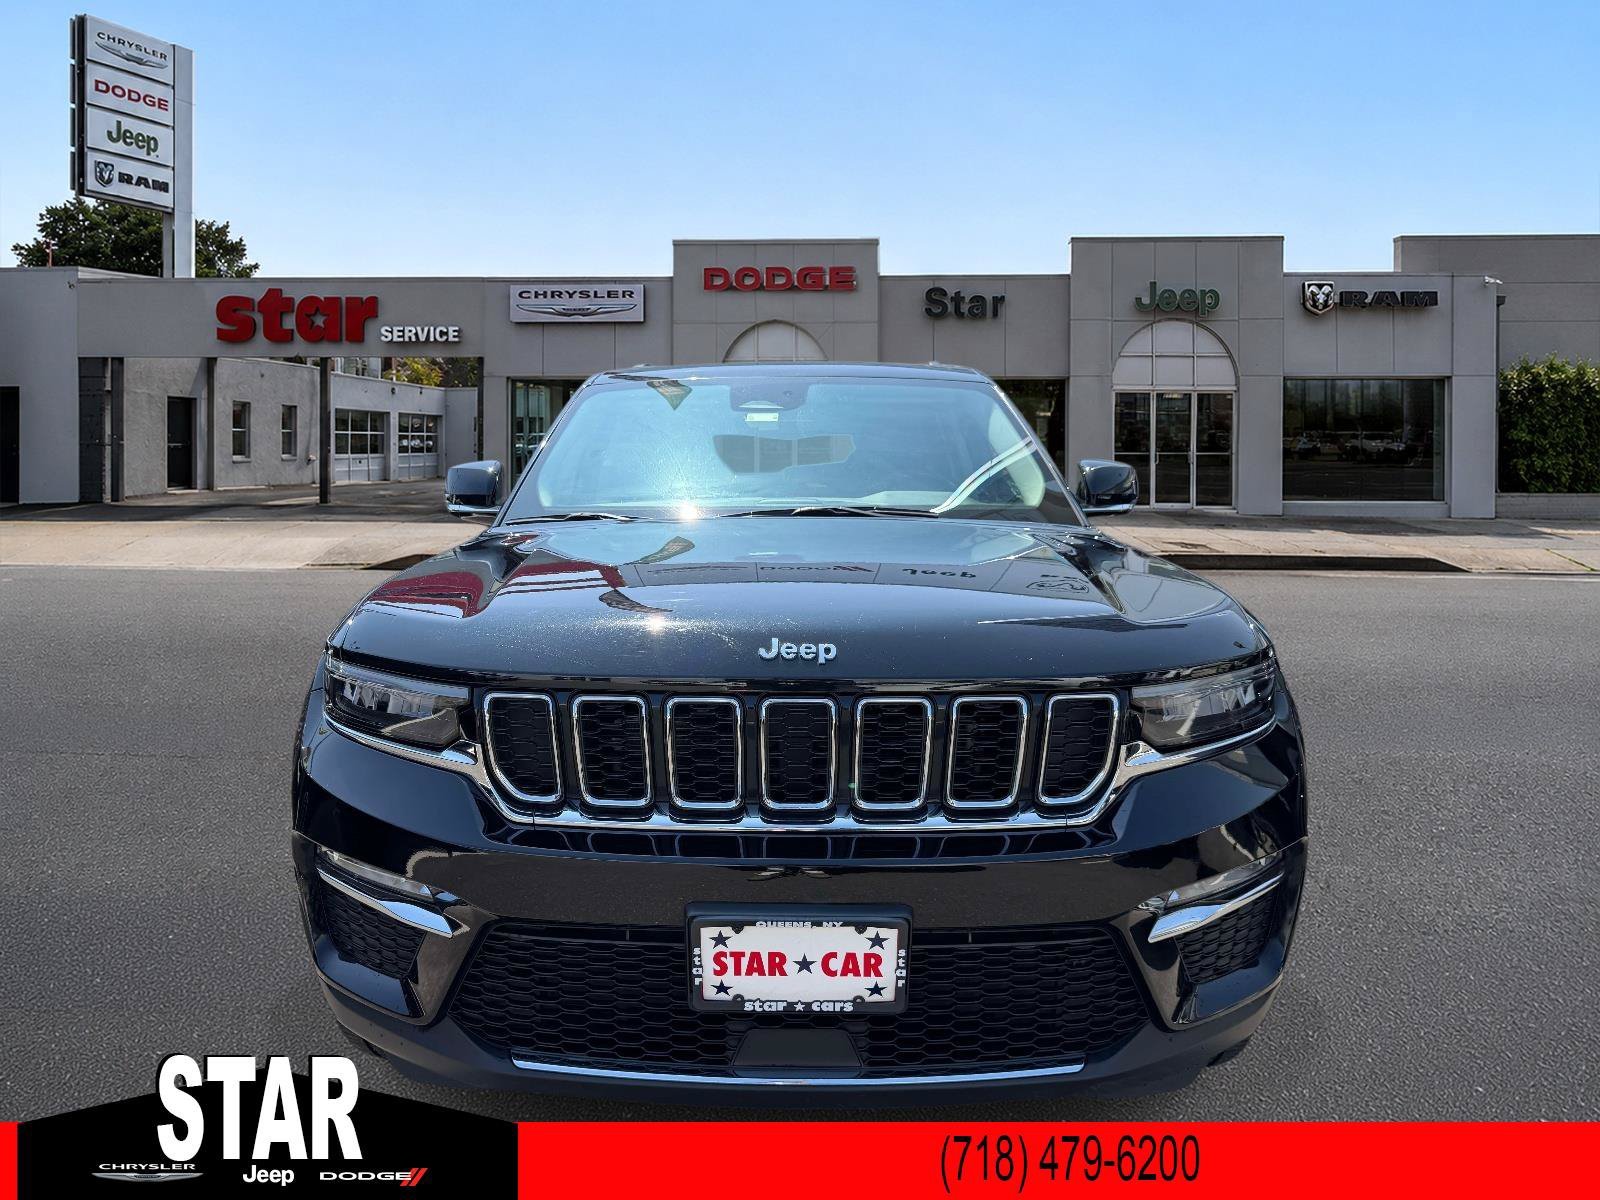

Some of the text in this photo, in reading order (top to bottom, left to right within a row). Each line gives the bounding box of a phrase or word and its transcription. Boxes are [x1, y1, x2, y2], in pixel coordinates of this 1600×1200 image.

[97, 32, 168, 61] CHRYSLER
[94, 79, 169, 112] DODGE
[106, 120, 159, 156] Jeep
[118, 172, 169, 193] RAM
[703, 267, 857, 292] DODGE
[517, 289, 636, 300] CHRYSLER
[924, 286, 1006, 320] Star
[1134, 281, 1220, 316] Jeep
[1338, 290, 1439, 308] RAM
[215, 287, 379, 343] star
[380, 325, 461, 343] SERVICE
[758, 637, 838, 665] Jeep
[713, 951, 883, 978] STAR CAR
[744, 998, 854, 1012] star cars
